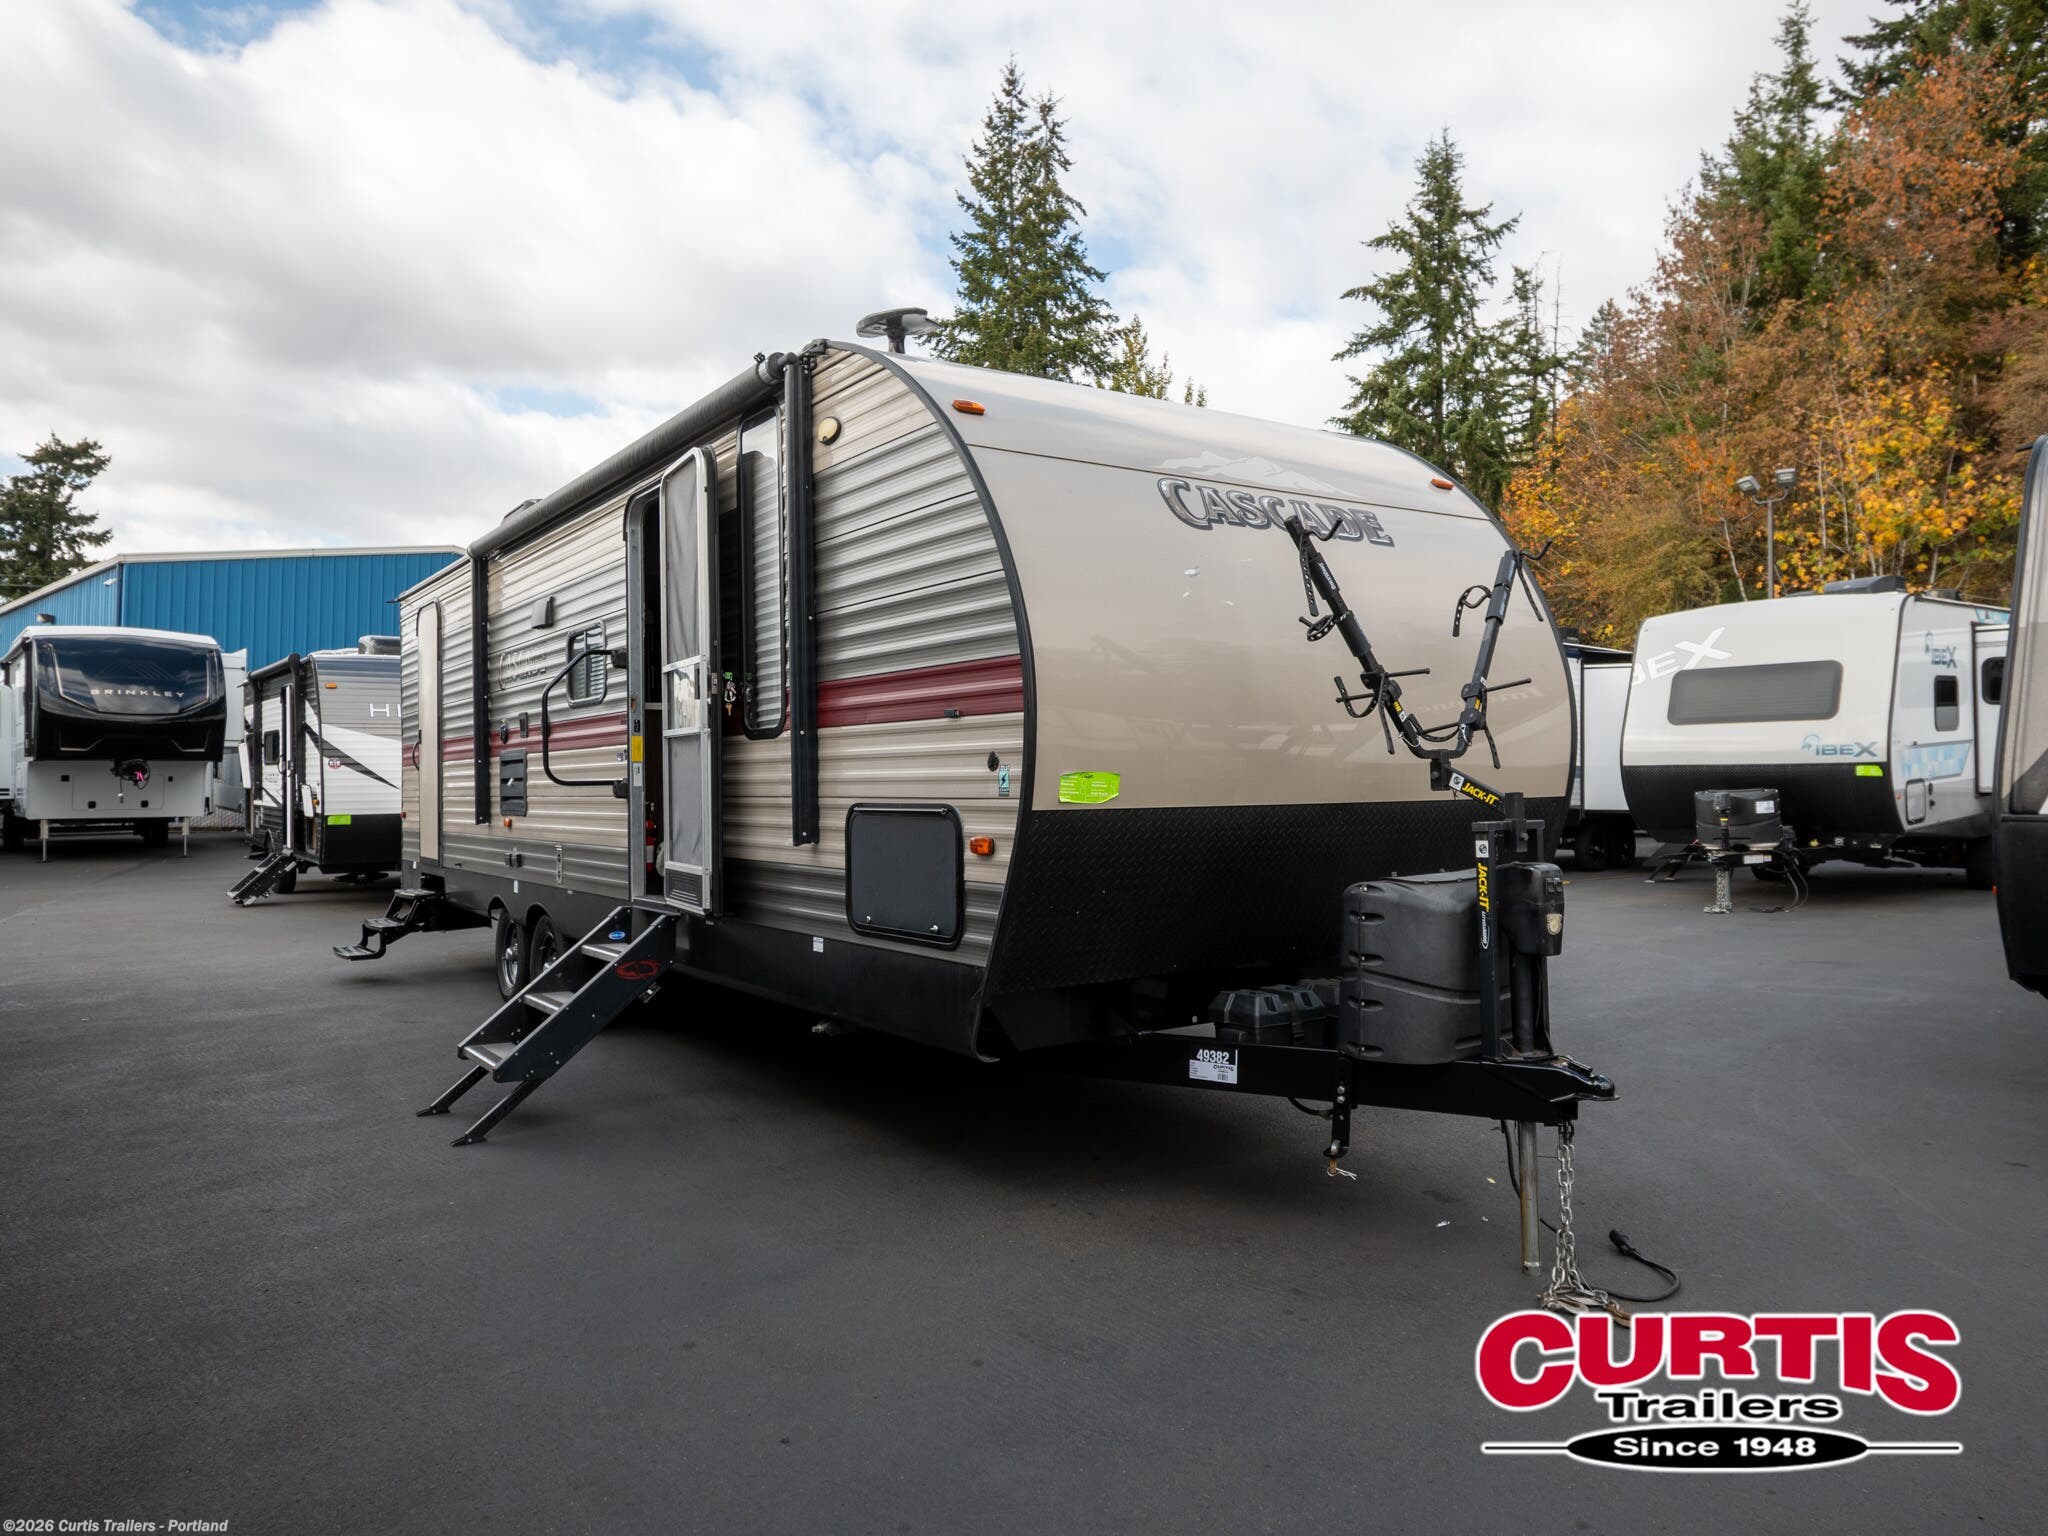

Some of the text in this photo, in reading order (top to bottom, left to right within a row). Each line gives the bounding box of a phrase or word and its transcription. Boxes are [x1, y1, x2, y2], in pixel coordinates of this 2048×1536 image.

[1157, 477, 1395, 548] CASCADE
[90, 688, 185, 698] BRINKLEY
[1815, 741, 1879, 757] IBEX
[1462, 782, 1500, 805] JACK-IT
[1478, 862, 1490, 912] JACK-IT
[1196, 1049, 1230, 1064] 49382
